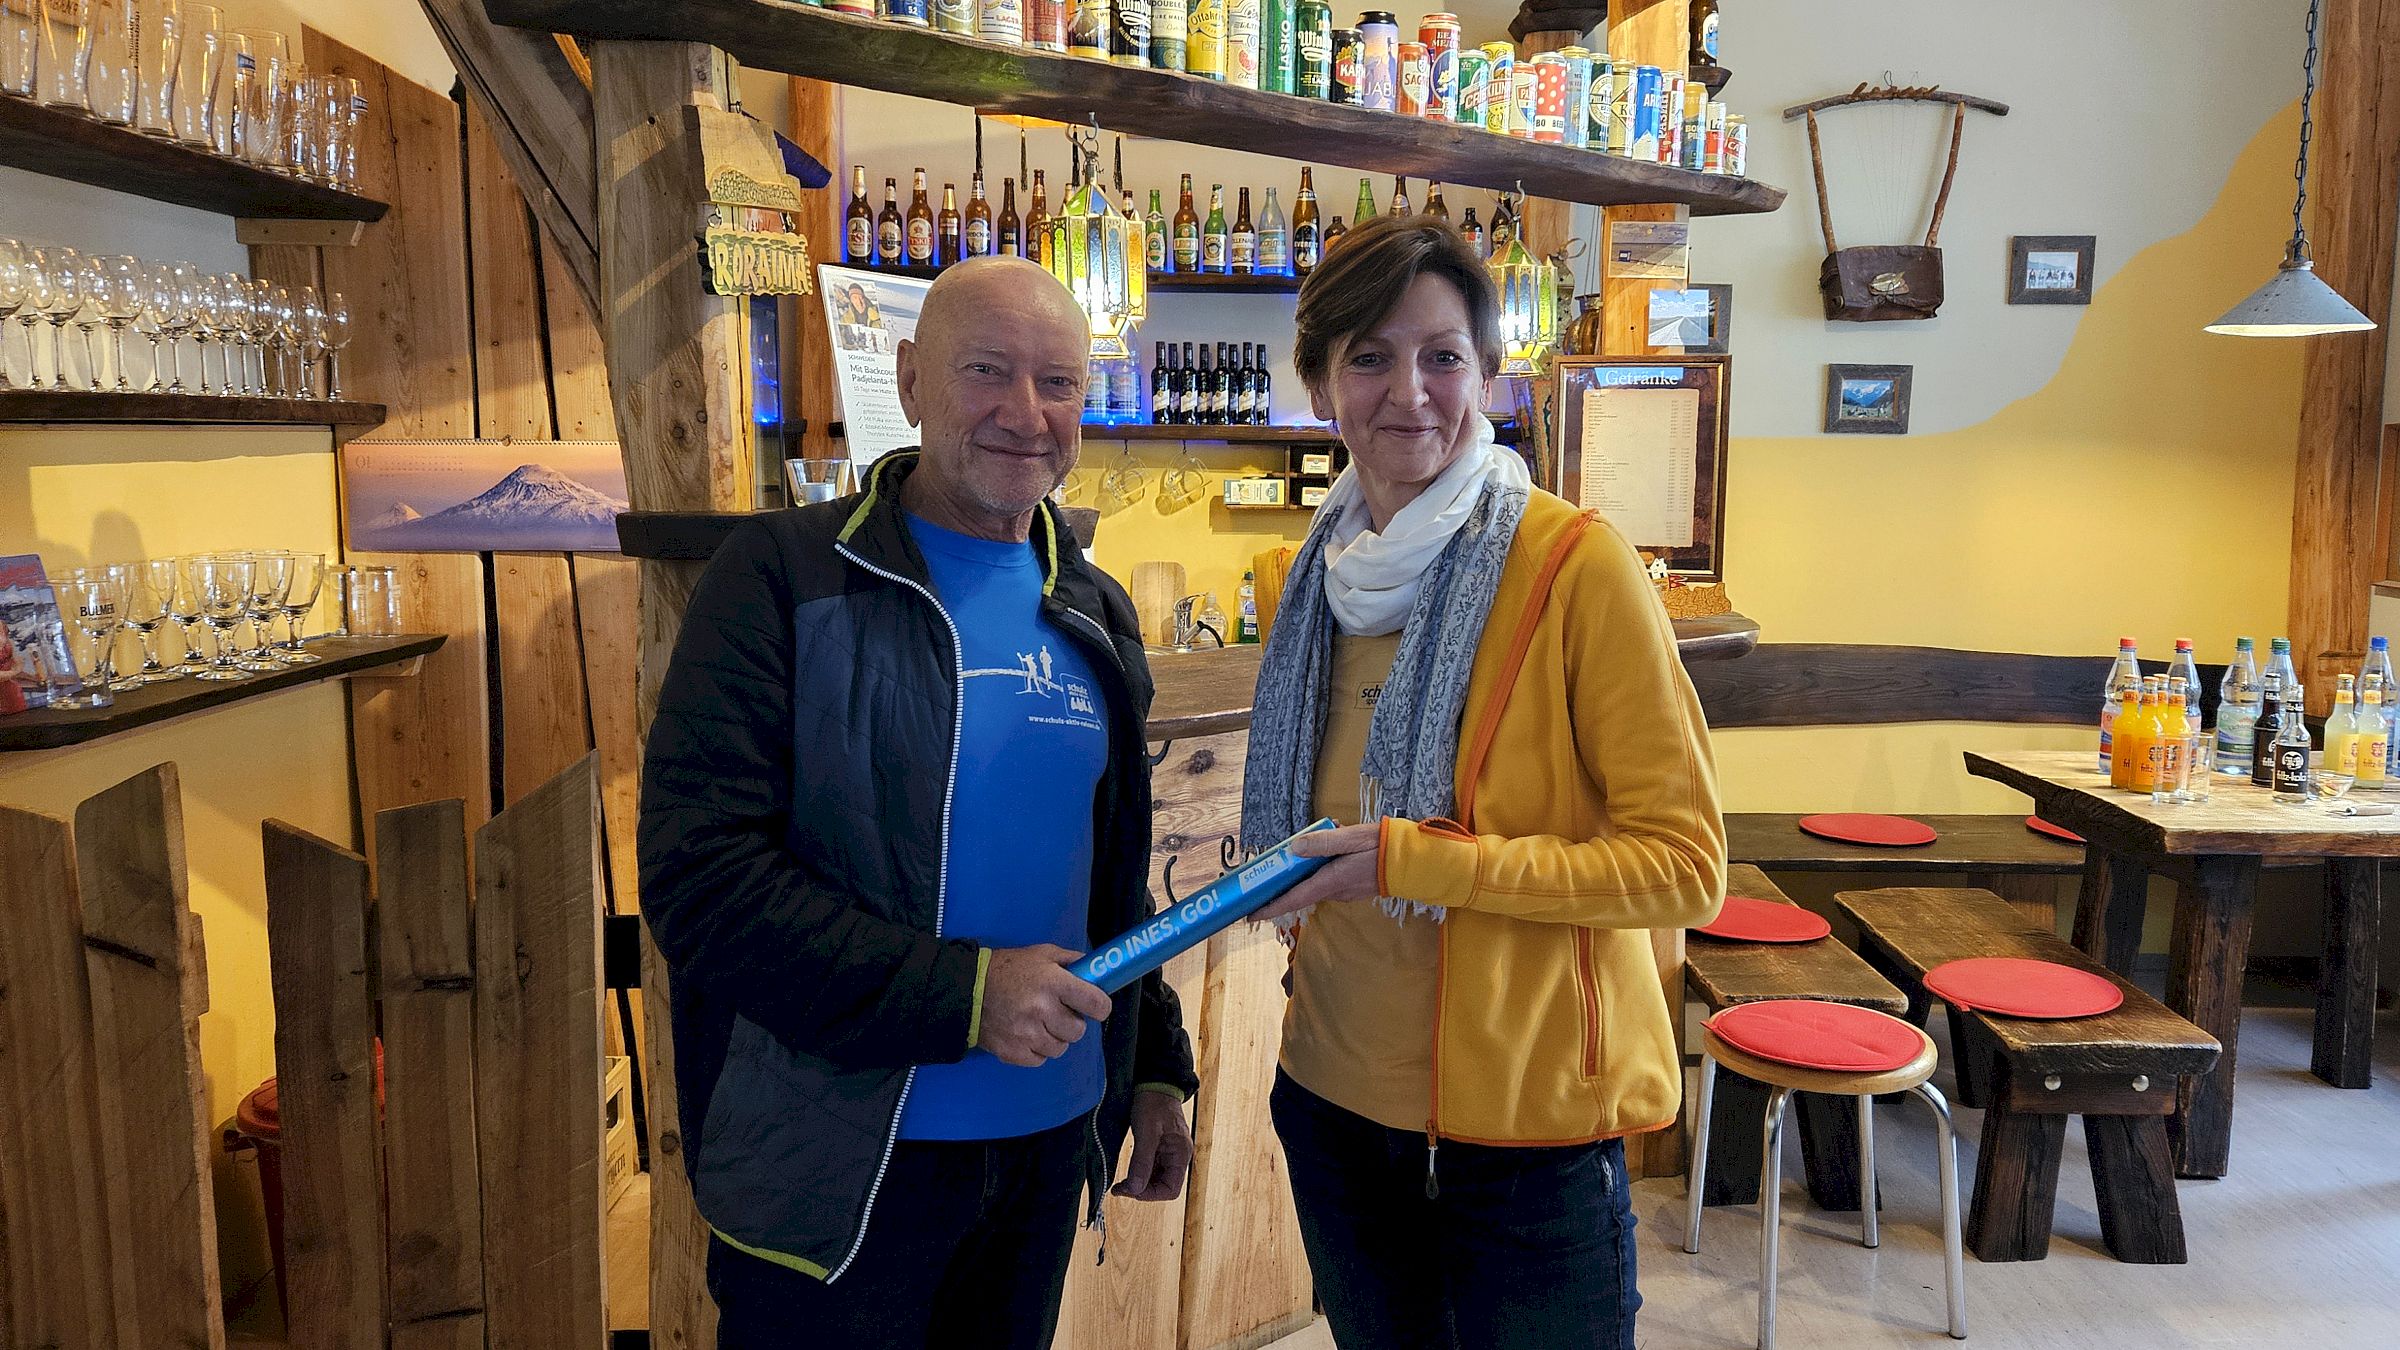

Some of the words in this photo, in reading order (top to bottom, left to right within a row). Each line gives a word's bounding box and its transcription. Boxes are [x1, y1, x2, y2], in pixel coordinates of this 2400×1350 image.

[714, 242, 811, 294] RORAIMA
[1605, 369, 1679, 386] Getränke
[1242, 858, 1276, 884] schulz
[1088, 935, 1124, 978] GO
[1121, 914, 1182, 958] INES,
[1179, 888, 1223, 926] GO!
